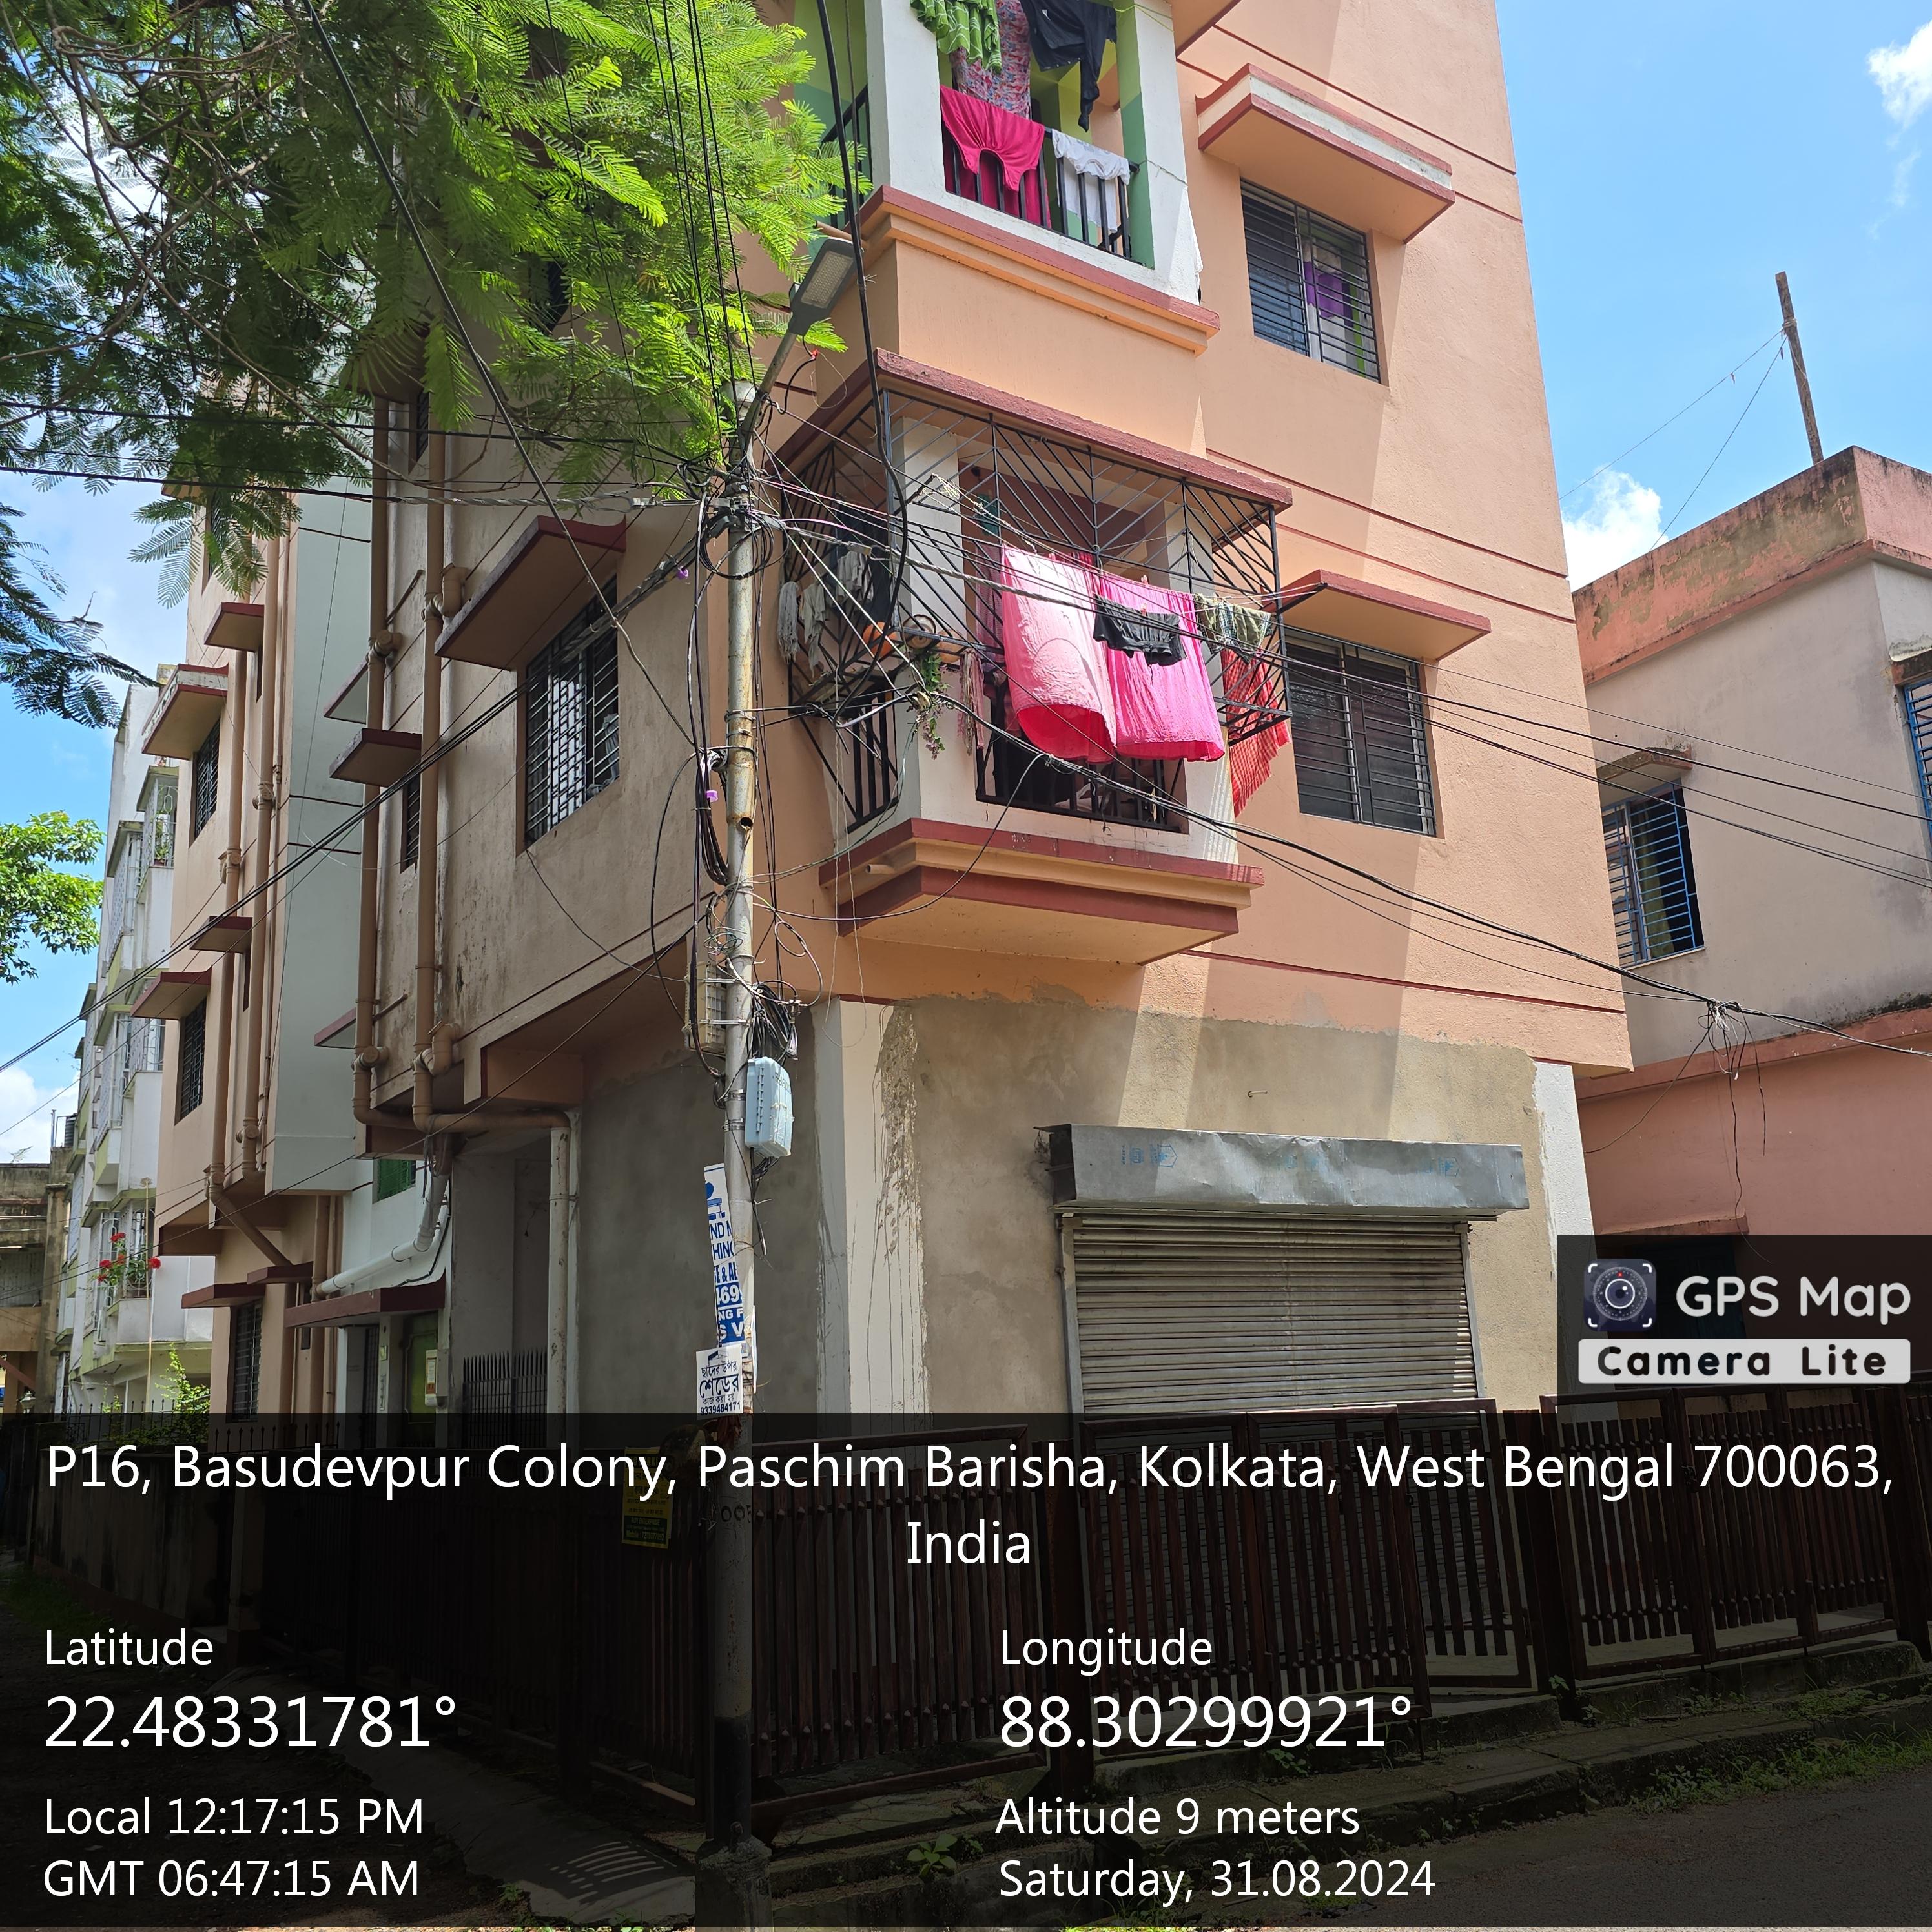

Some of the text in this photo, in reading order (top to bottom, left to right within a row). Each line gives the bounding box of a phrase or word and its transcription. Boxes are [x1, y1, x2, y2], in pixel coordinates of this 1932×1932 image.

[722, 1266, 728, 1282] &
[731, 1322, 744, 1337] V
[701, 1361, 737, 1379] ছাদের উপর
[699, 1374, 739, 1398] শেডের
[703, 1397, 714, 1405] কাজ
[715, 1395, 725, 1403] করা
[700, 1401, 741, 1416] 9339484171
